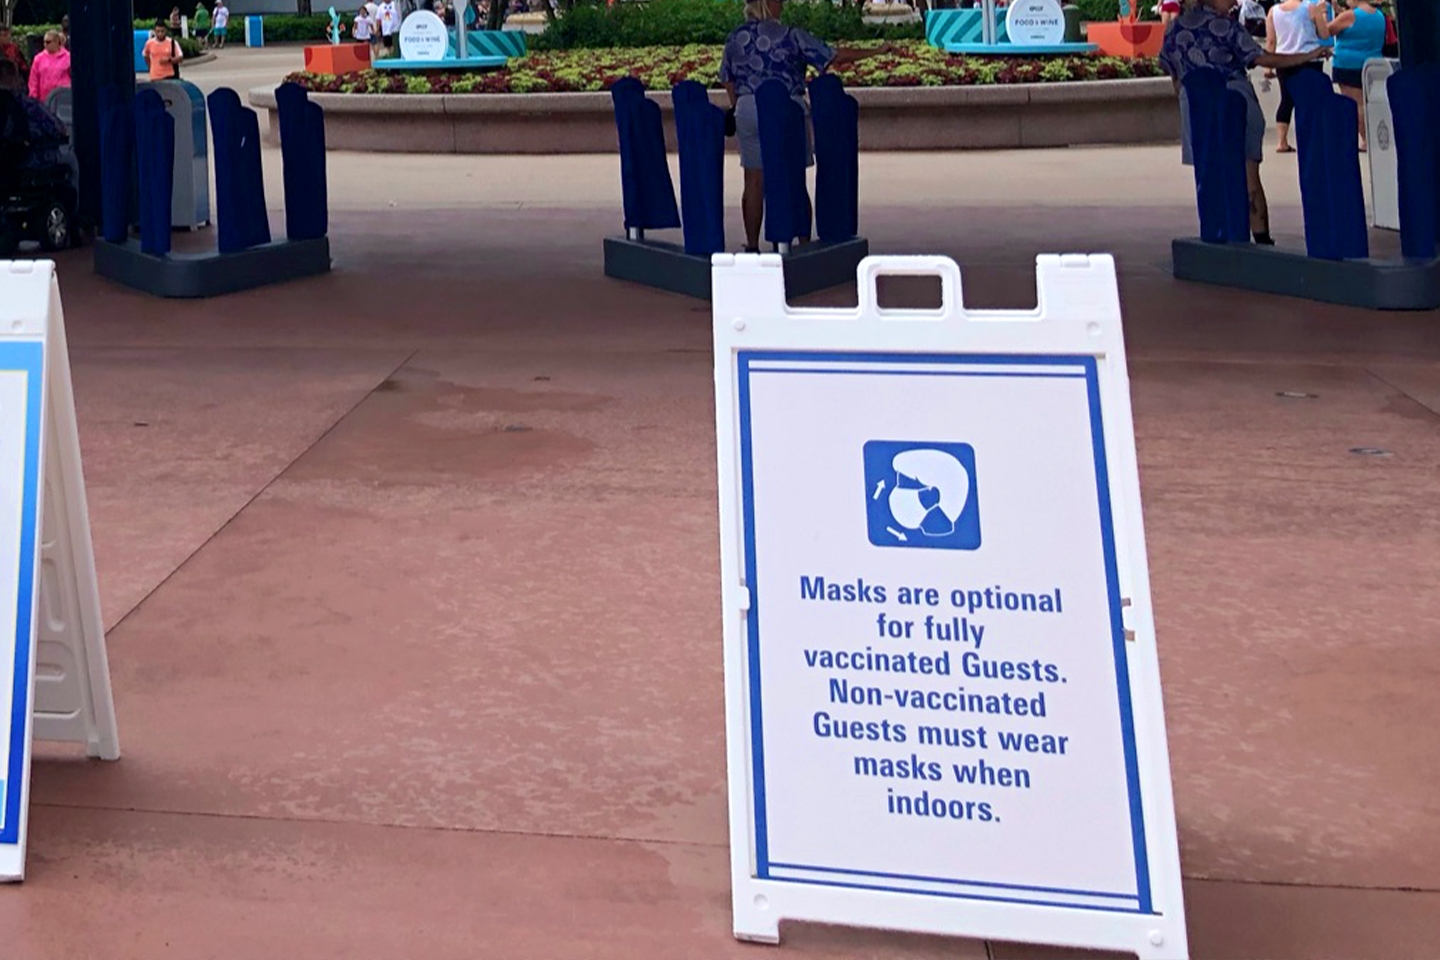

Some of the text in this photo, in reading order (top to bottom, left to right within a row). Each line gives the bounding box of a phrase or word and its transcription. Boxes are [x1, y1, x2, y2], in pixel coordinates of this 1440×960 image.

[800, 576, 1063, 614] Masks are optional
[877, 614, 985, 648] for fully
[804, 646, 1068, 683] vaccinated Guests.
[829, 679, 1046, 716] Non-vaccinated
[814, 711, 1068, 755] Guests must wear
[854, 754, 1031, 788] masks when
[888, 788, 1001, 823] indoors.
